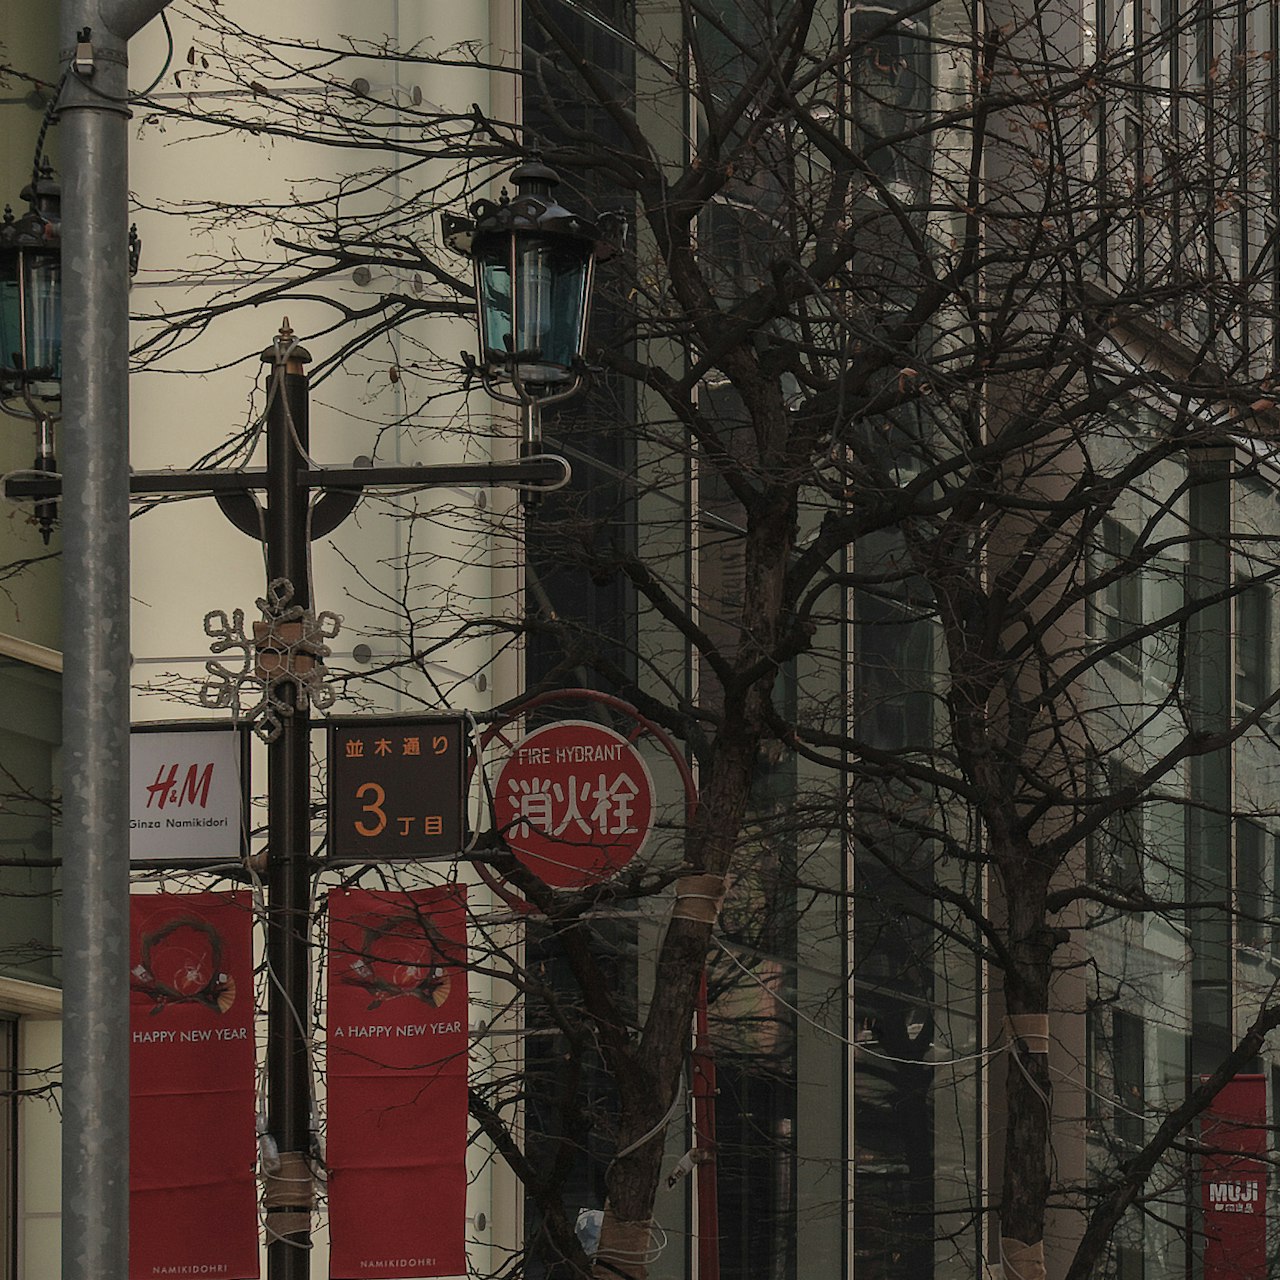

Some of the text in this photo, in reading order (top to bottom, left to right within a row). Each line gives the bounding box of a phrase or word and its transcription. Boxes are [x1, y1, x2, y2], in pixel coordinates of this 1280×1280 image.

[345, 735, 449, 758] 並木通り
[518, 743, 624, 766] FIRE HYDRANT
[146, 762, 215, 810] H&M
[353, 782, 443, 838] 3丁目
[507, 771, 640, 840] 消火栓
[128, 816, 229, 829] Ginza Namikidori
[132, 1027, 248, 1043] HAPPY NEW YEAR
[334, 1021, 462, 1038] A HAPPY NEW YEAR
[1209, 1181, 1258, 1203] MUJI
[152, 1264, 228, 1275] NAMIKIDOHRI
[360, 1257, 437, 1269] NAMIKIDOHRI
